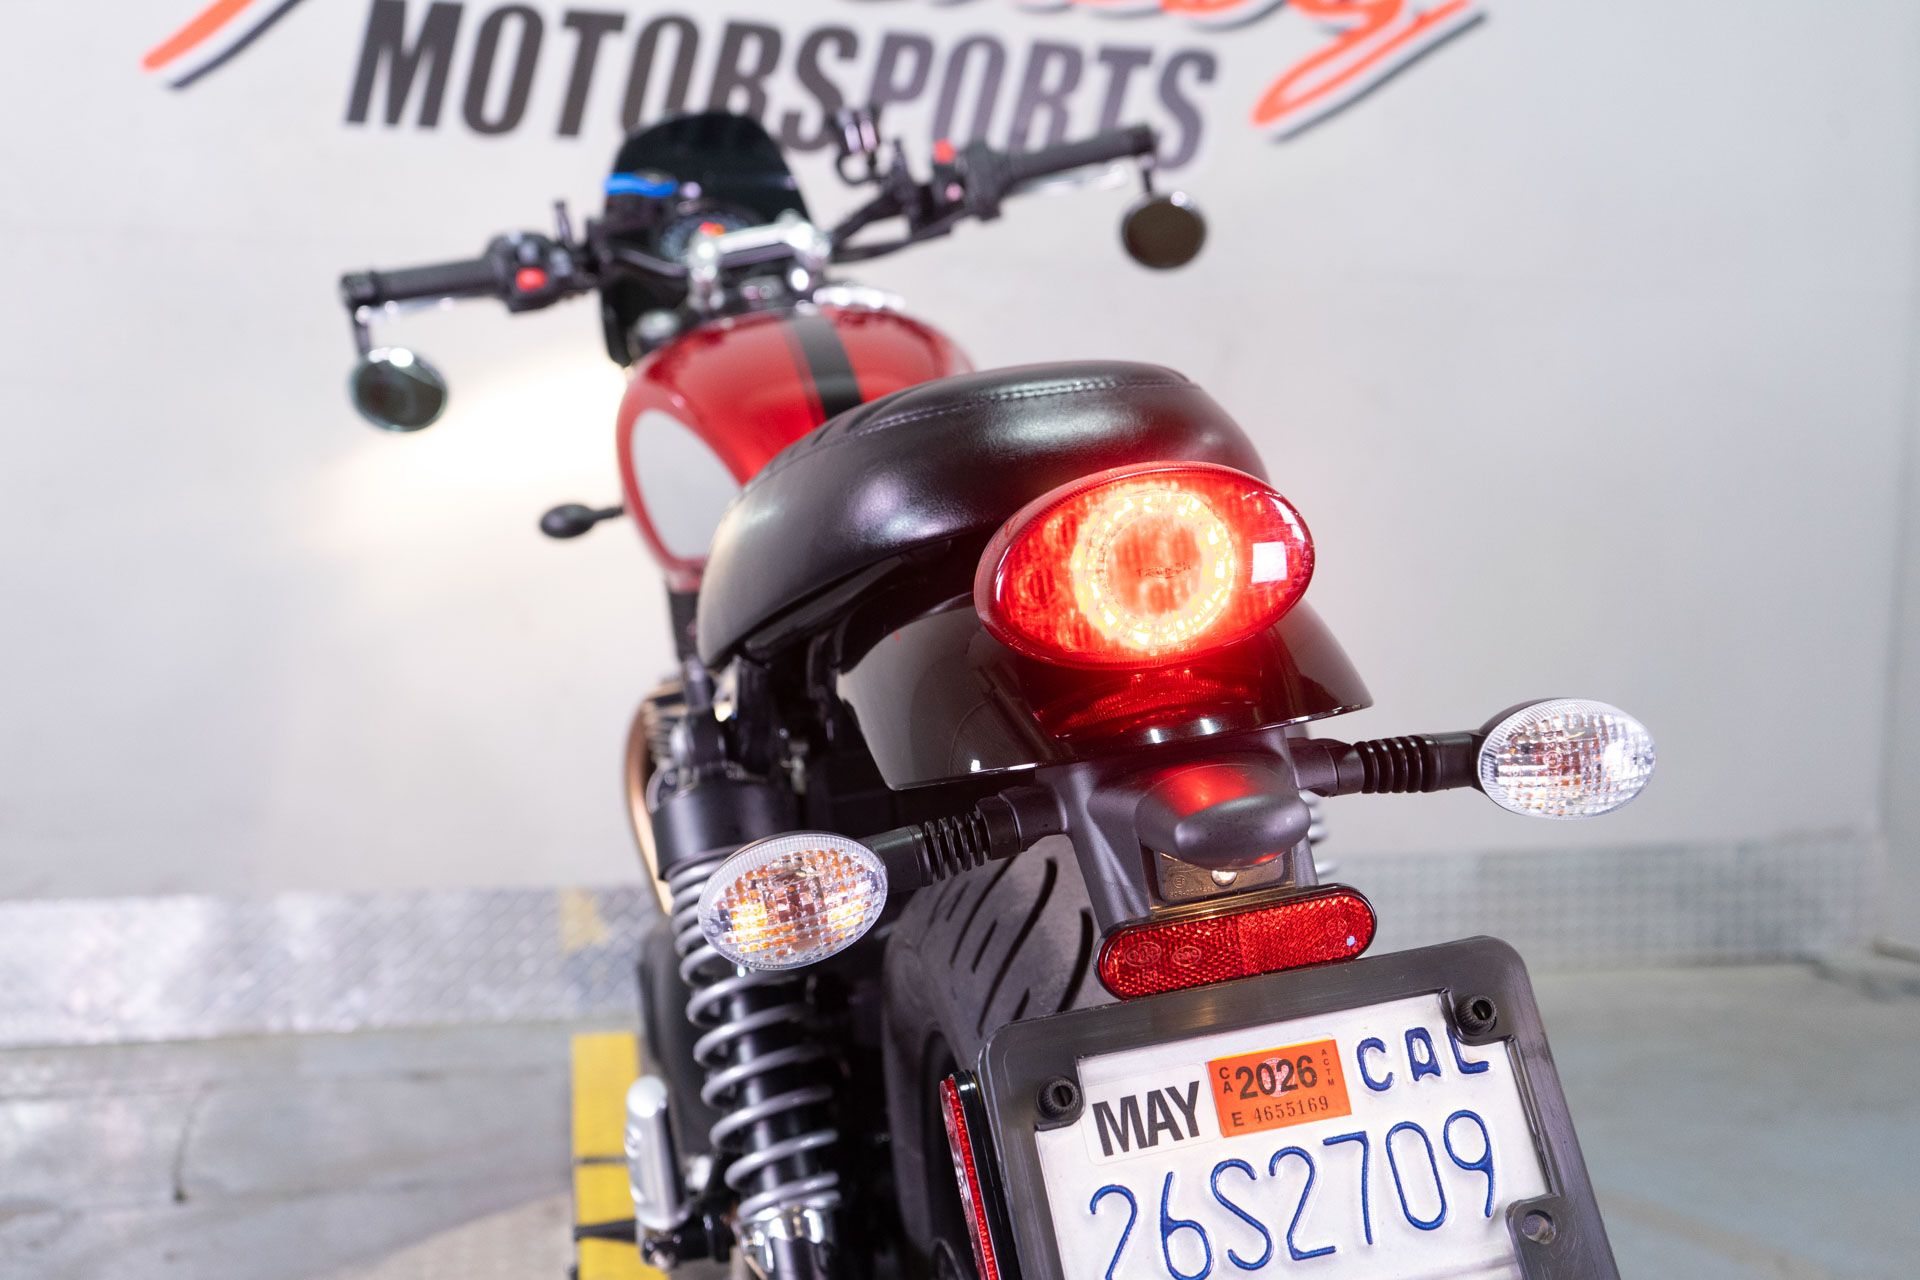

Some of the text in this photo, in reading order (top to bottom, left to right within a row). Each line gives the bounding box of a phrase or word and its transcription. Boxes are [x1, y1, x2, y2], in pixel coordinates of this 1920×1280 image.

[345, 0, 1217, 169] MOTORSPORTS
[1235, 1055, 1317, 1100] 2026
[1356, 1025, 1489, 1091] CAL
[1092, 1081, 1200, 1157] MAY
[1254, 1095, 1329, 1124] 4655169
[1090, 1109, 1494, 1280] 26S2709
